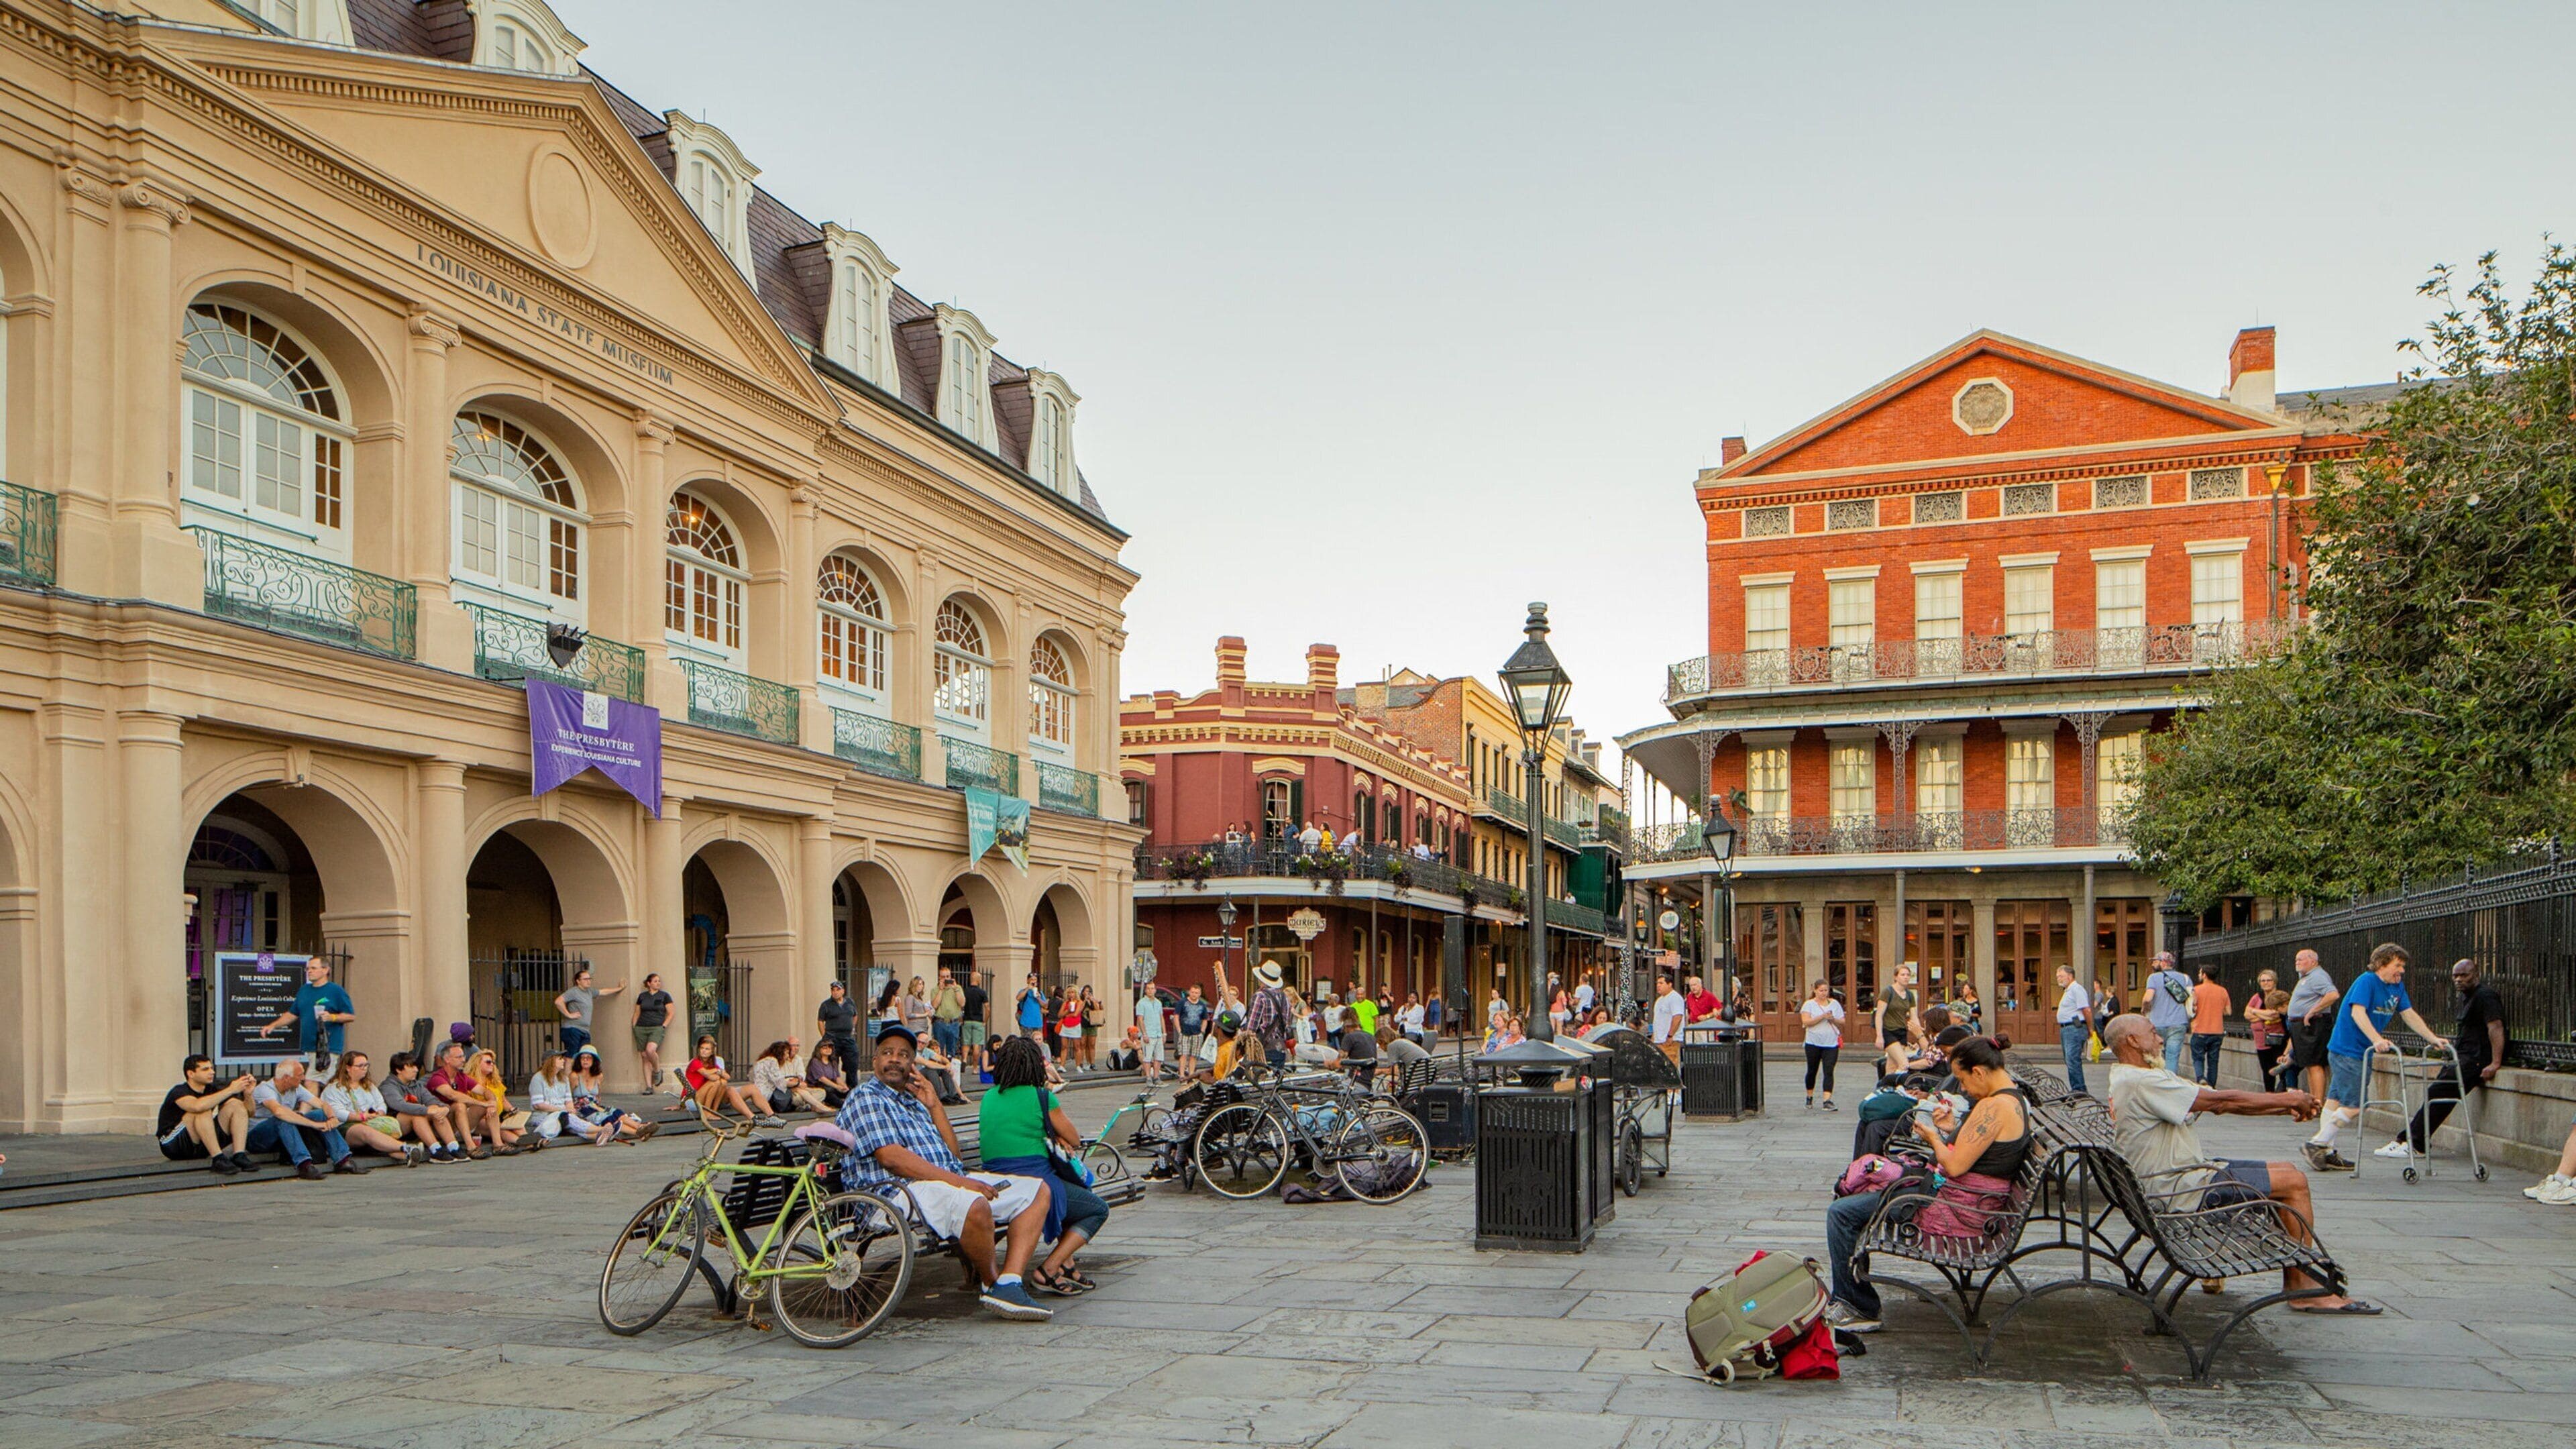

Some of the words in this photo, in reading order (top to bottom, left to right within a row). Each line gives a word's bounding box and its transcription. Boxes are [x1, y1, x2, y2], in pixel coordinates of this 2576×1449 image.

[417, 244, 529, 314] LOUISIANA
[537, 306, 595, 348] STATE
[602, 338, 674, 386] MUSEUM
[557, 728, 576, 741] THE
[577, 733, 635, 752] PRESBYTÈRE
[551, 743, 584, 758] EXPERIENCE
[584, 751, 615, 763] LOUISIANA
[616, 757, 641, 767] CULTURE
